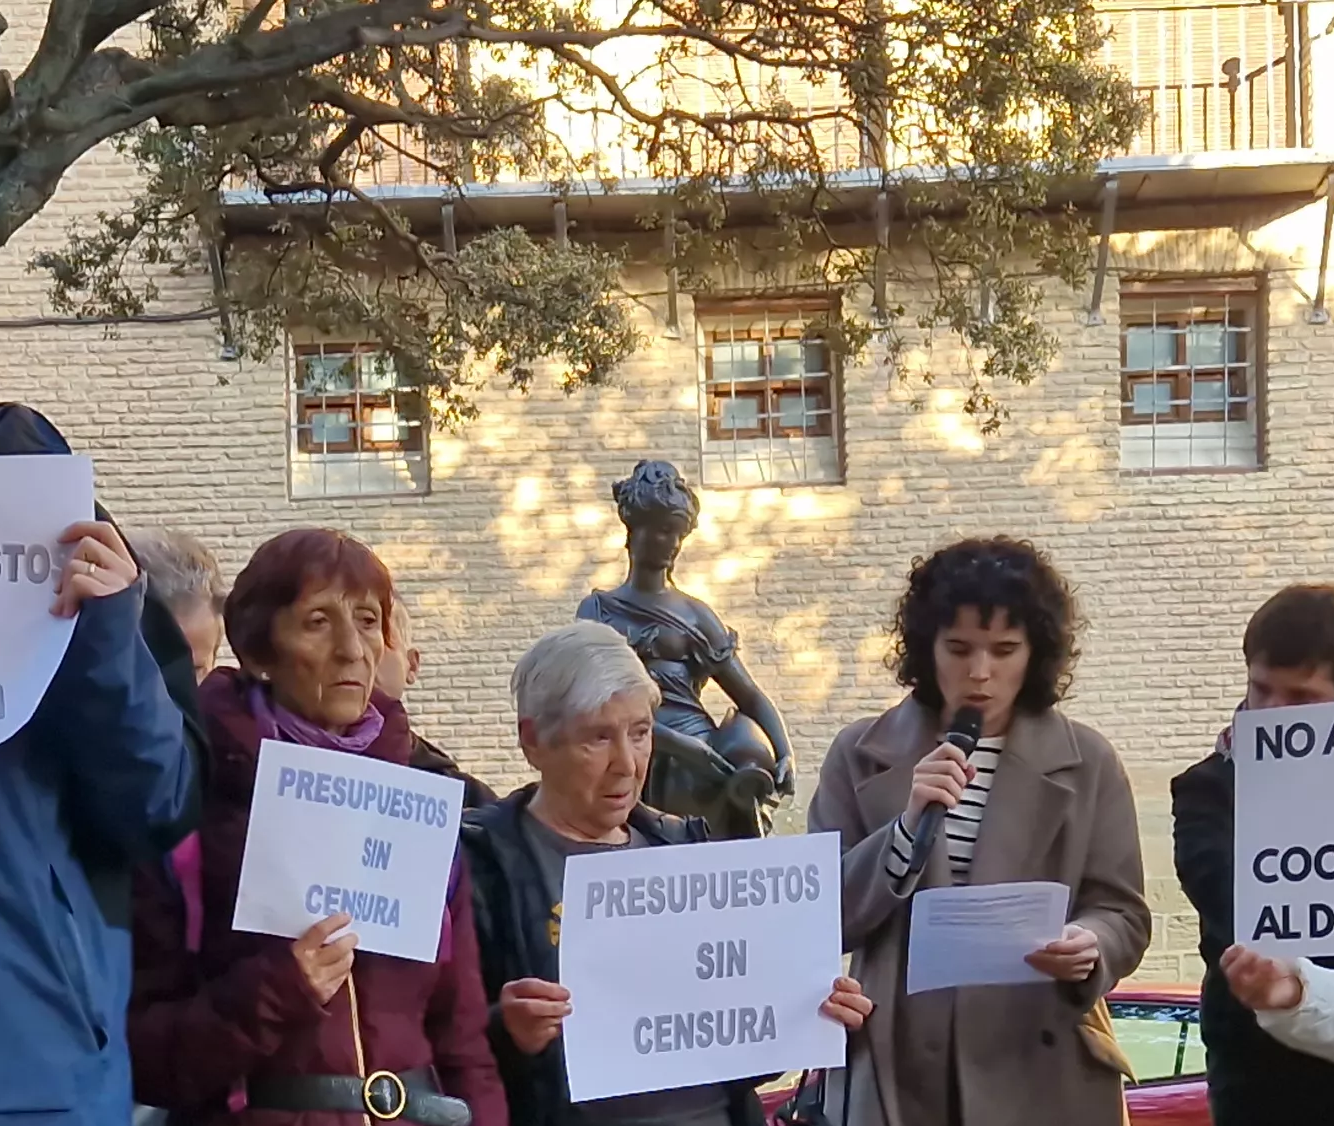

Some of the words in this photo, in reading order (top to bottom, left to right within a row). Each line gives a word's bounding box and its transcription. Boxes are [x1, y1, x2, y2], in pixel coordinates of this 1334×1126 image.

[1254, 721, 1316, 761] NO
[277, 766, 449, 829] PRESUPUESTOS
[361, 837, 393, 871] SIN
[304, 884, 401, 929] CENSURA
[584, 863, 821, 919] PRESUPUESTOS
[1252, 904, 1302, 941] AL
[695, 939, 747, 980] SIN
[633, 1005, 777, 1055] CENSURA
